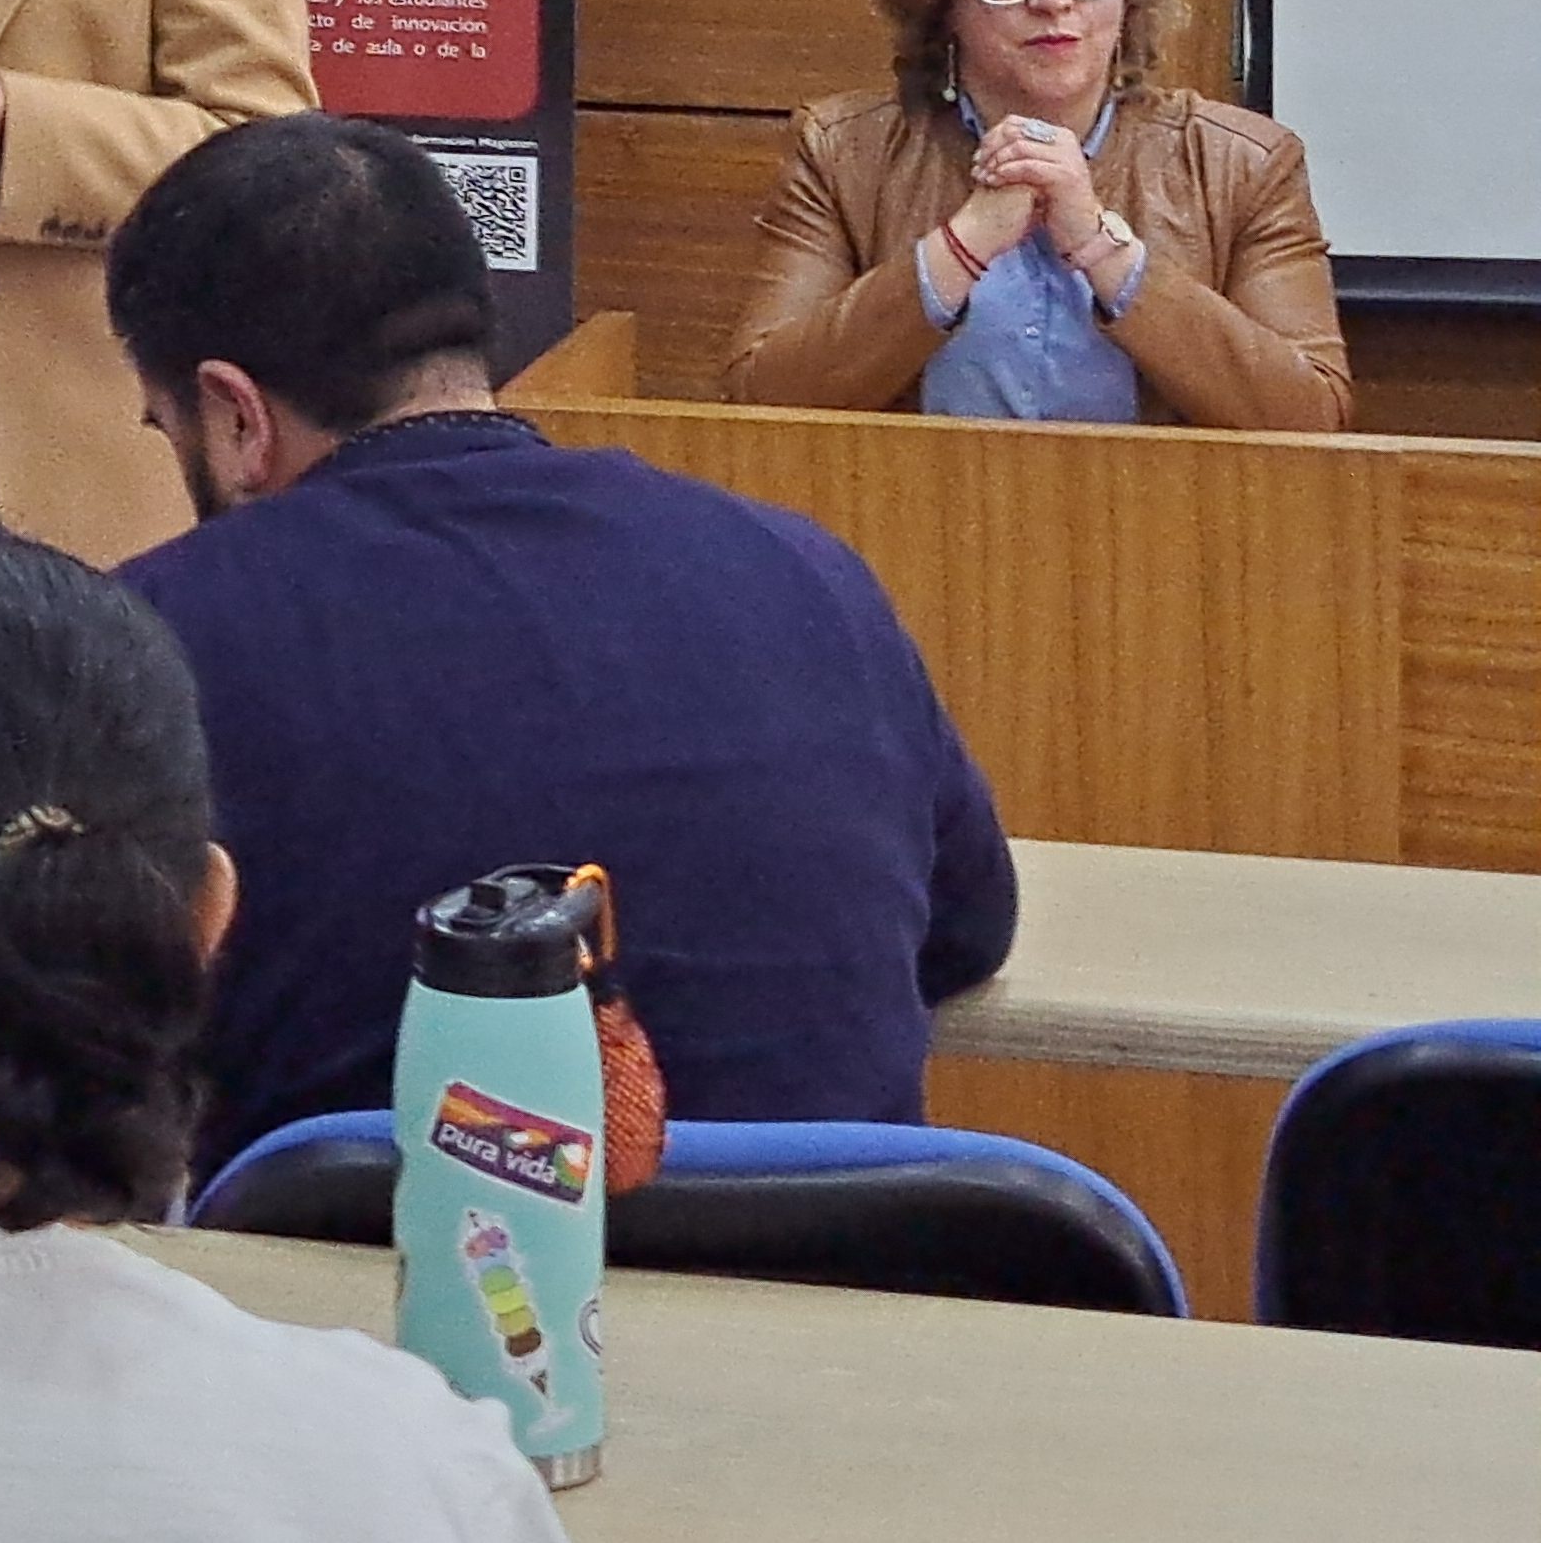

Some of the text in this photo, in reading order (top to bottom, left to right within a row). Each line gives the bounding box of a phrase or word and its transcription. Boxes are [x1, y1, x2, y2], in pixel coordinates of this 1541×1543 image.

[351, 13, 375, 30] de
[332, 38, 356, 54] de
[413, 43, 427, 56] o
[437, 42, 460, 58] de
[471, 43, 487, 59] la
[438, 1122, 557, 1184] pura vida
